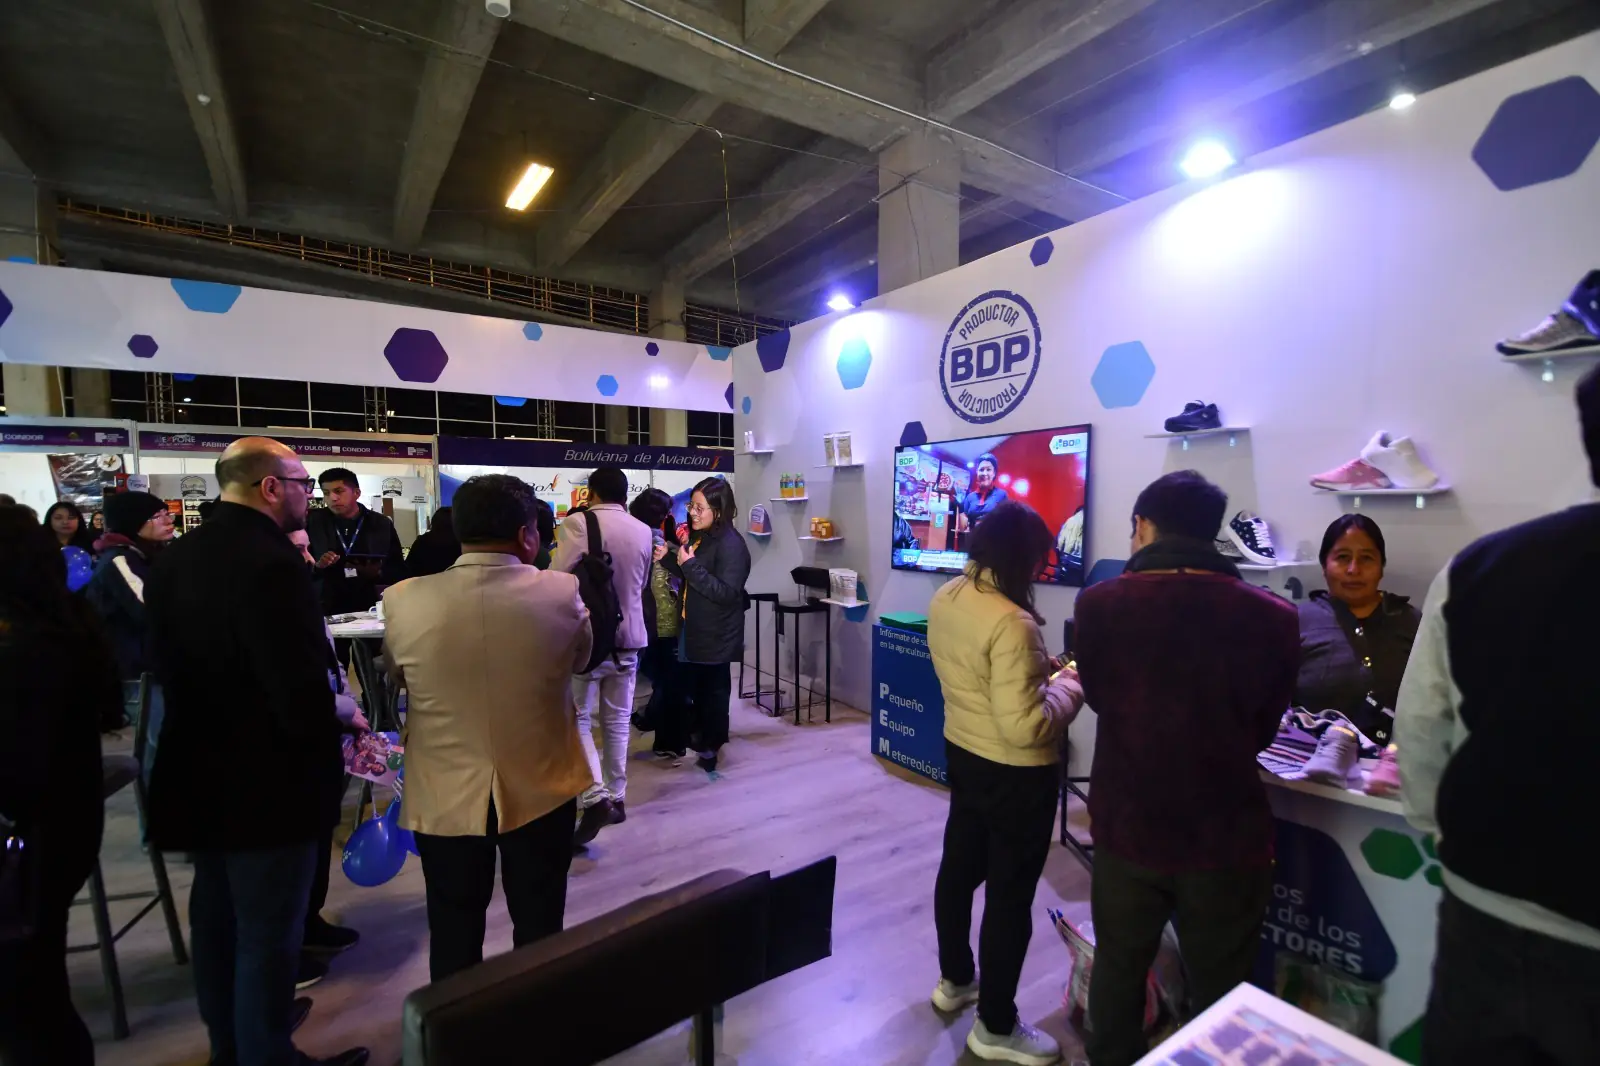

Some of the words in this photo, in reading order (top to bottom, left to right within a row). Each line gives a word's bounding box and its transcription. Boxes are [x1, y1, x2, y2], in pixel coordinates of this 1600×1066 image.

[958, 303, 1020, 341] PRODUCTOR
[950, 334, 1030, 383] BDP
[958, 382, 1019, 414] PRODUCTOR
[4, 433, 45, 441] CONDOR
[1062, 439, 1081, 448] BDP
[563, 449, 629, 463] Boliviana
[633, 453, 652, 464] de
[656, 453, 710, 466] Aviación
[899, 457, 914, 466] BDP
[903, 555, 918, 563] BDP
[879, 627, 911, 643] Infórmate
[911, 636, 920, 645] de
[879, 641, 888, 649] en
[888, 642, 895, 650] la
[879, 682, 924, 713] Pequeño
[879, 709, 916, 737] Equipo
[1277, 905, 1310, 931] de
[1317, 916, 1362, 948] los
[1260, 921, 1364, 974] TORES
